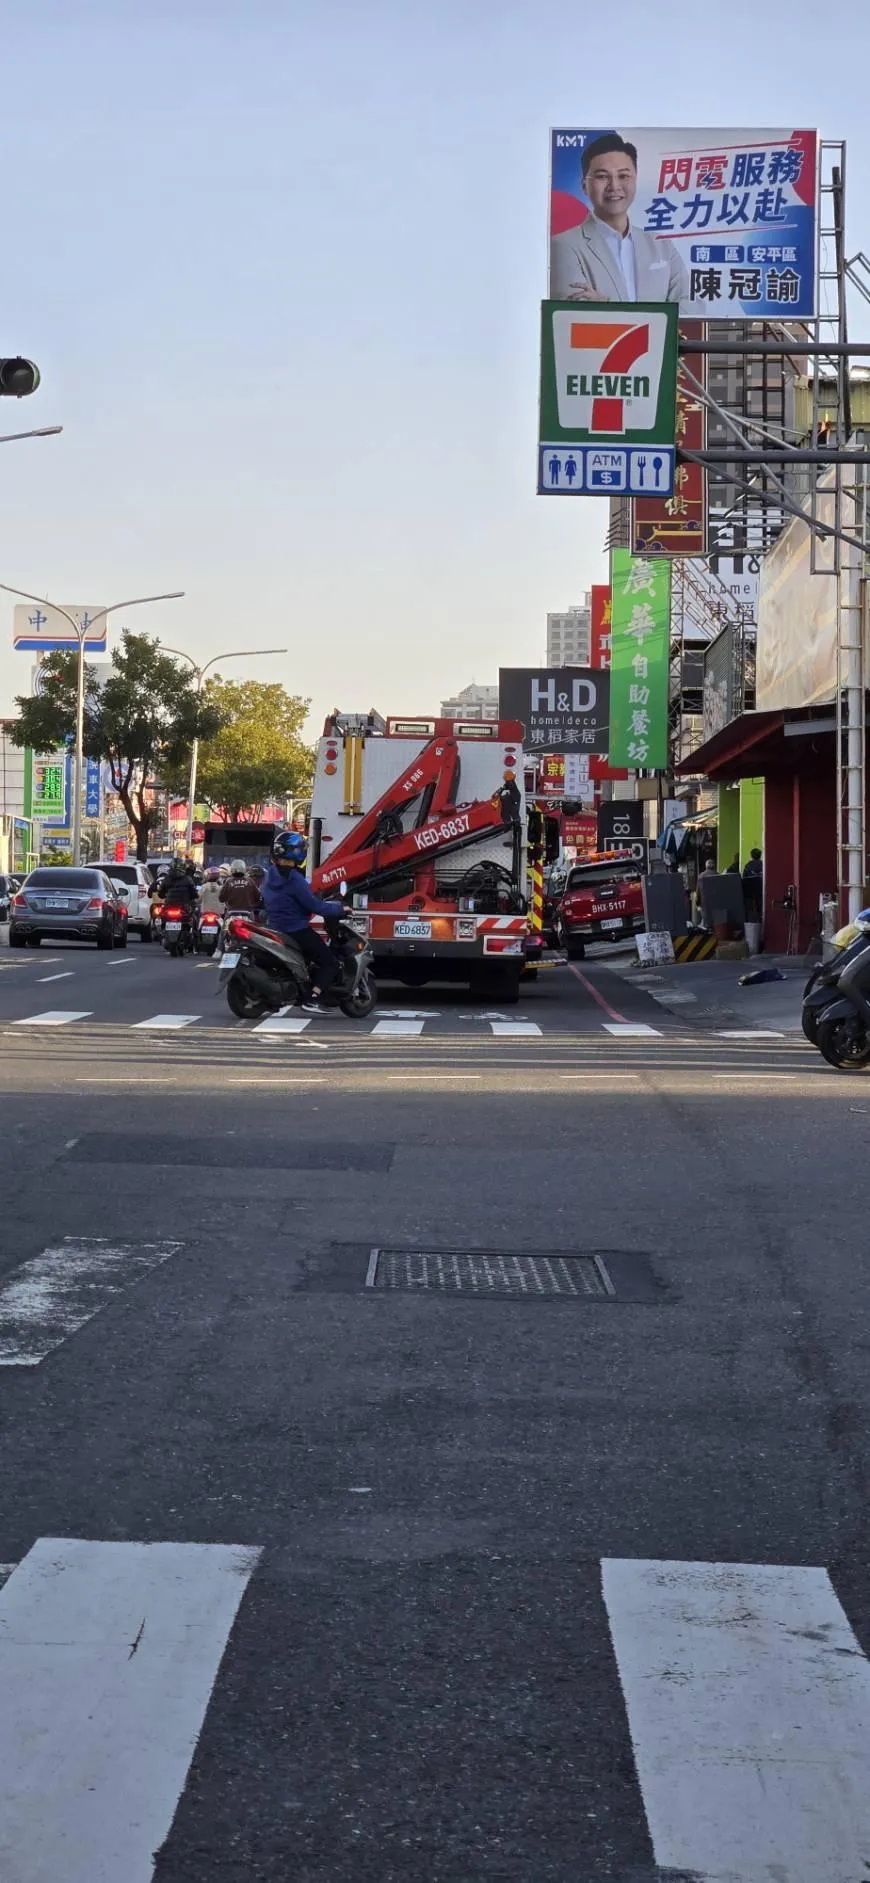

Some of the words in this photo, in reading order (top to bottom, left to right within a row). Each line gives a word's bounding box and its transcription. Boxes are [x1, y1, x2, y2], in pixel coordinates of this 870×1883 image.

[556, 134, 587, 147] KMT
[657, 150, 804, 193] 閃電服務
[643, 188, 788, 232] 全力以赴
[751, 246, 797, 262] 安平區
[689, 268, 799, 303] 陳冠諭
[592, 455, 622, 466] ATM
[531, 678, 597, 712] H&D
[531, 729, 596, 744] 東稻家居
[414, 815, 470, 850] KED-6837
